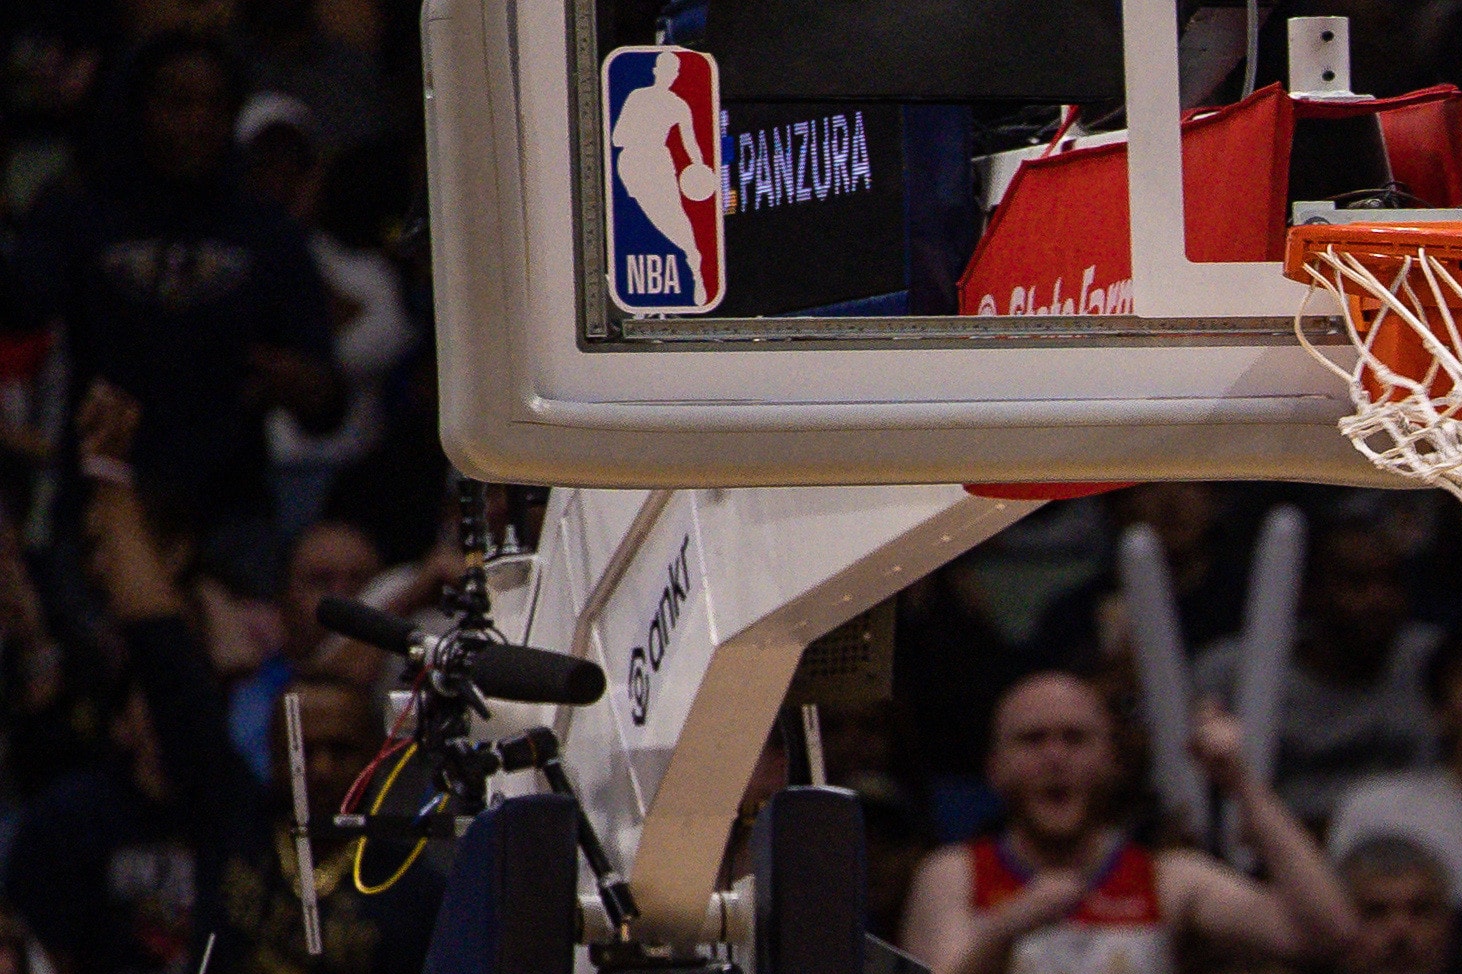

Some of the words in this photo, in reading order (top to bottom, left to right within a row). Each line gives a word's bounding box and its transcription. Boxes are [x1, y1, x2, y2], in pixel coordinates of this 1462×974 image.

[738, 110, 873, 213] PANZURA
[626, 254, 682, 294] NBA
[649, 533, 691, 673] ankr
